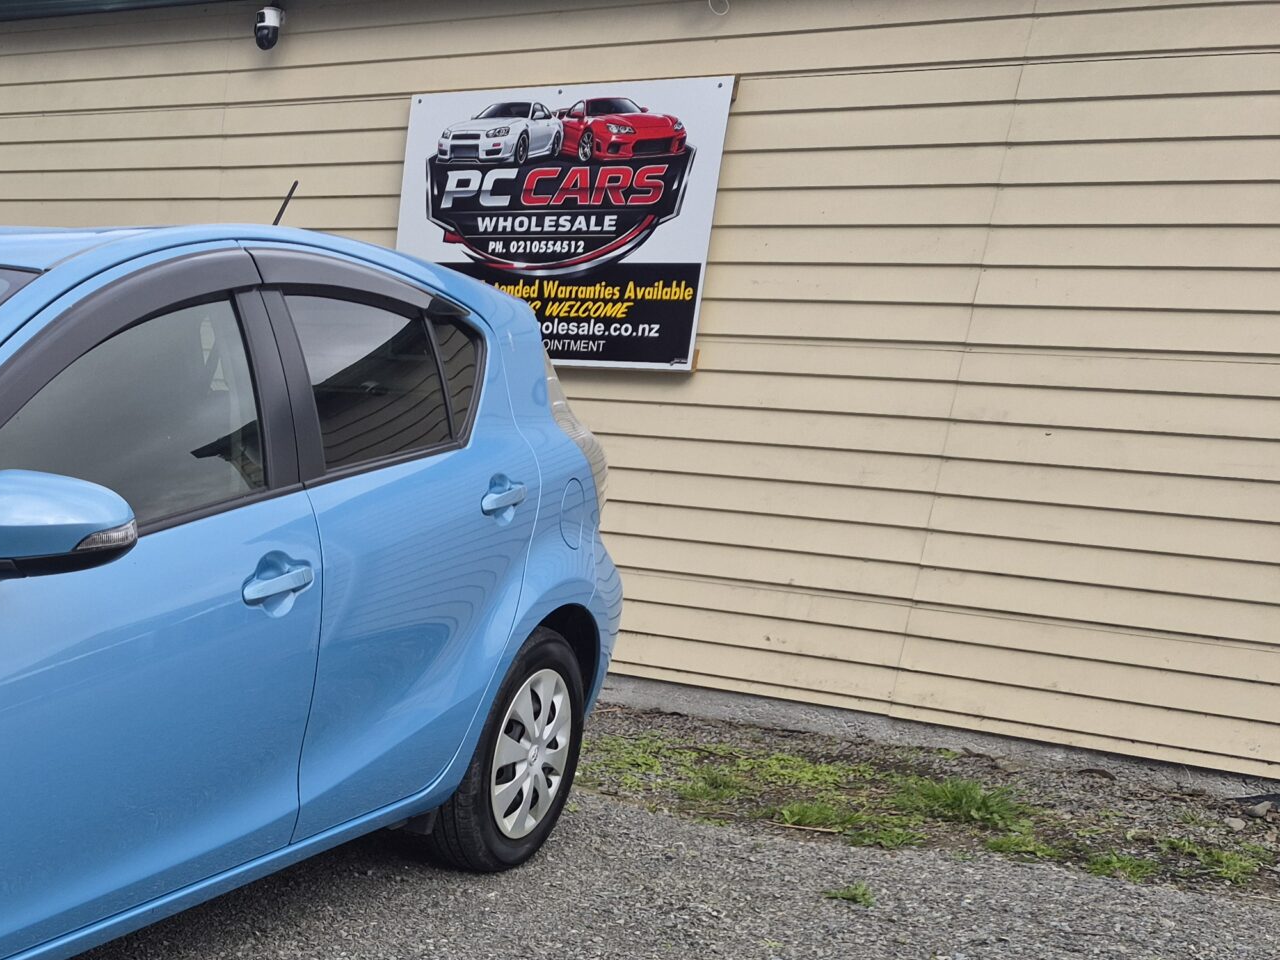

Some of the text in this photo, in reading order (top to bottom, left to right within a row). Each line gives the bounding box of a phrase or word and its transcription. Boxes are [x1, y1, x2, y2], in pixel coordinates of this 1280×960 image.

[440, 164, 669, 209] PC CARS
[477, 214, 618, 233] WHOLESALE
[488, 241, 585, 253] PH. 0210554512
[543, 280, 620, 299] Warranties
[624, 281, 694, 301] Available
[545, 301, 634, 318] WELCOME
[538, 318, 660, 337] olesale.co.nz
[542, 339, 606, 352] OINTMENT
